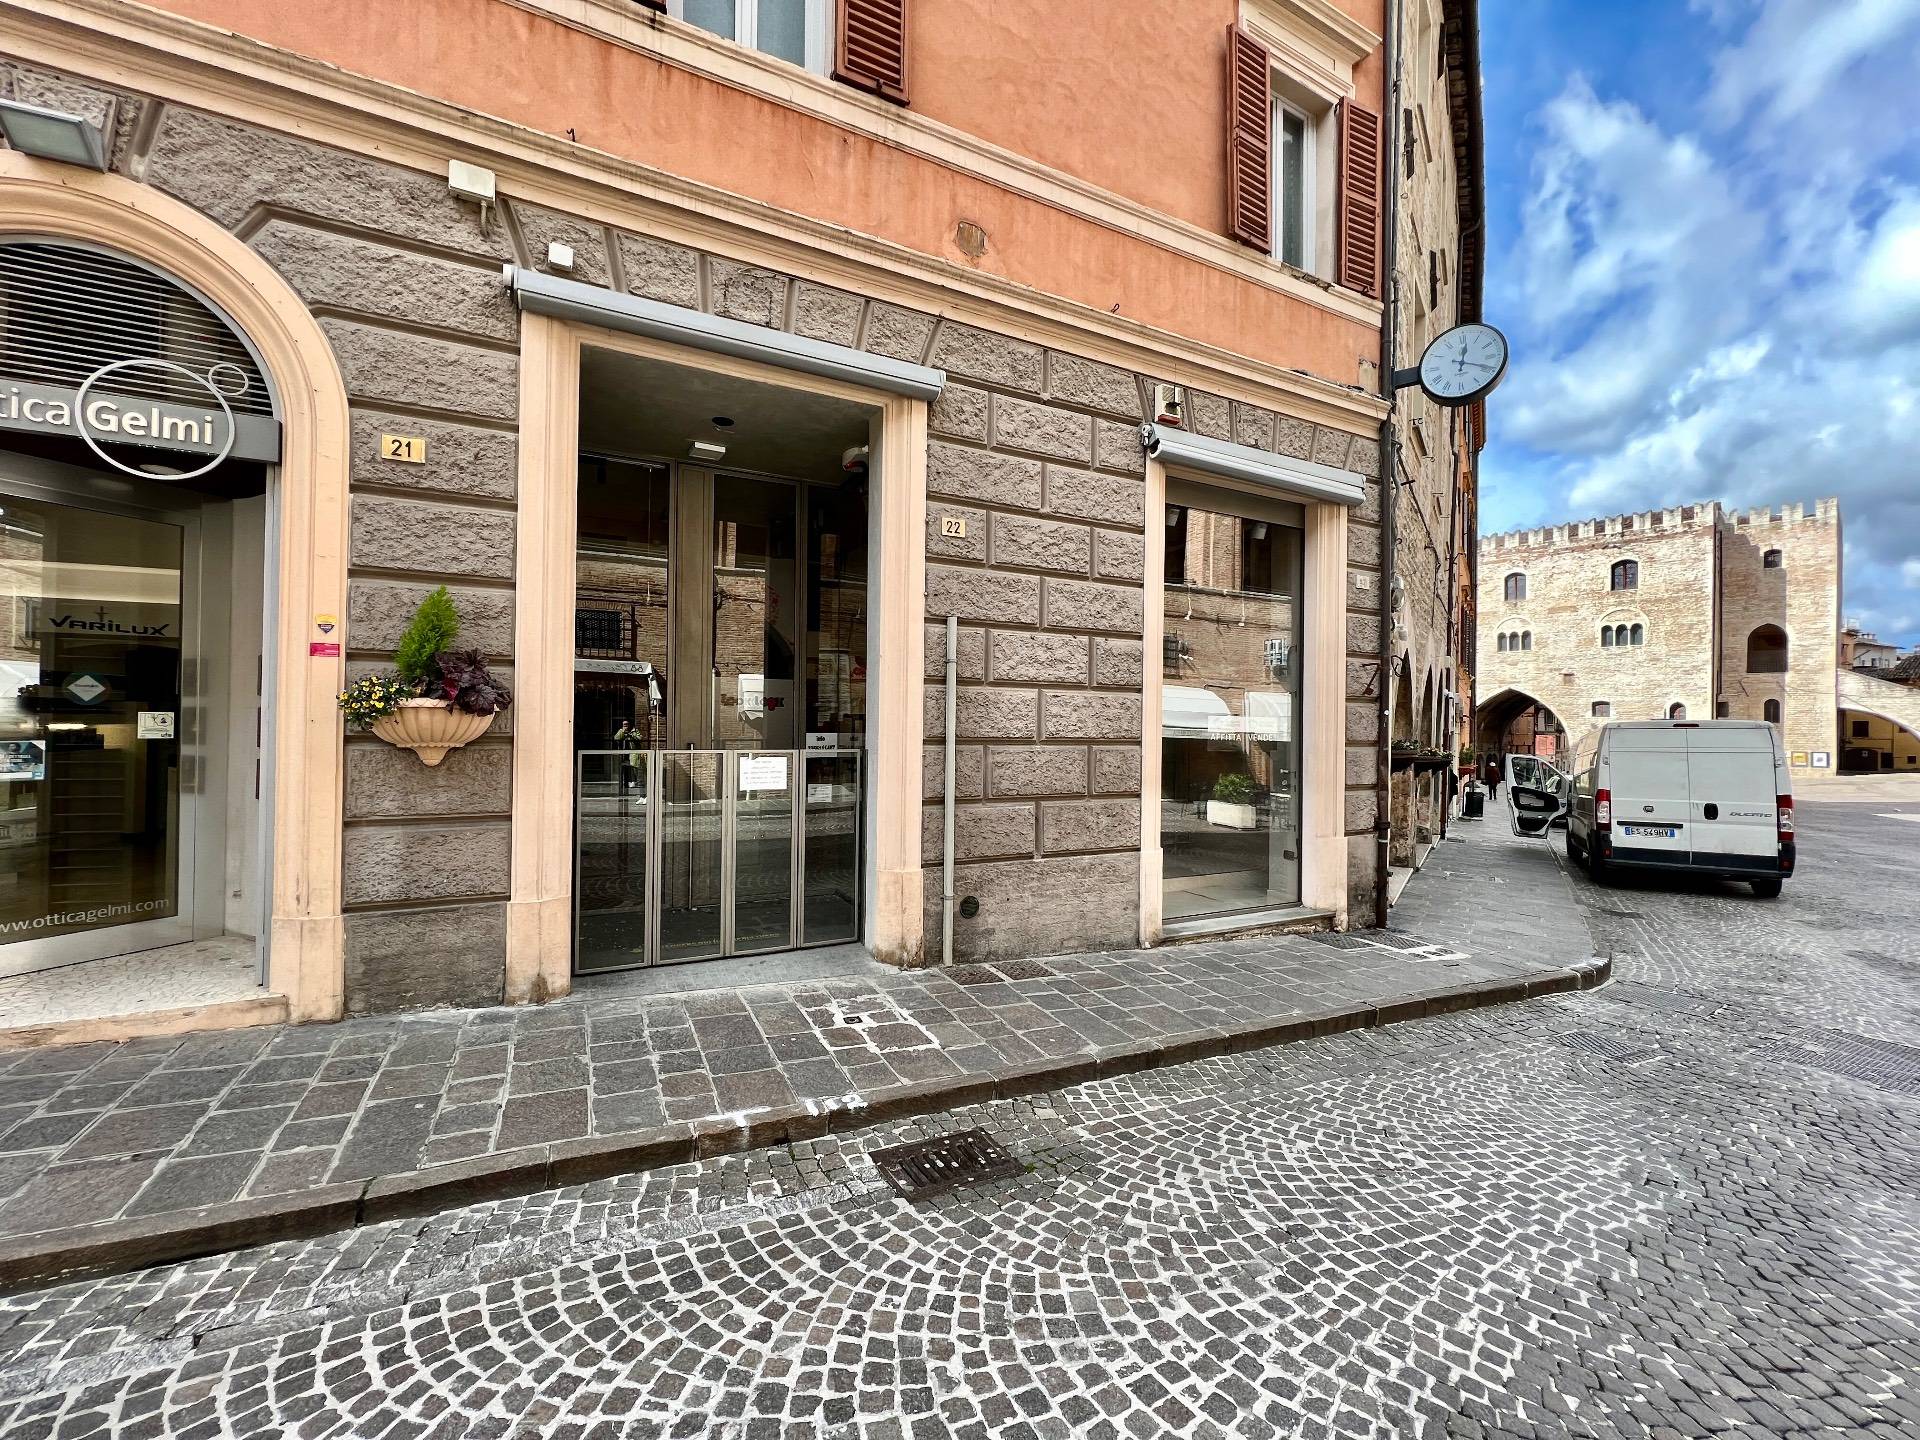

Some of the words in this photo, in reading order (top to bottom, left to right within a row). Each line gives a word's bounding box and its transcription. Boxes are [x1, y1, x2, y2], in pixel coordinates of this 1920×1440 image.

[86, 400, 213, 445] Gelmi
[391, 439, 412, 458] 21
[946, 520, 961, 535] 22
[1210, 733, 1242, 741] AFFITTA
[1247, 733, 1274, 742] VENDE
